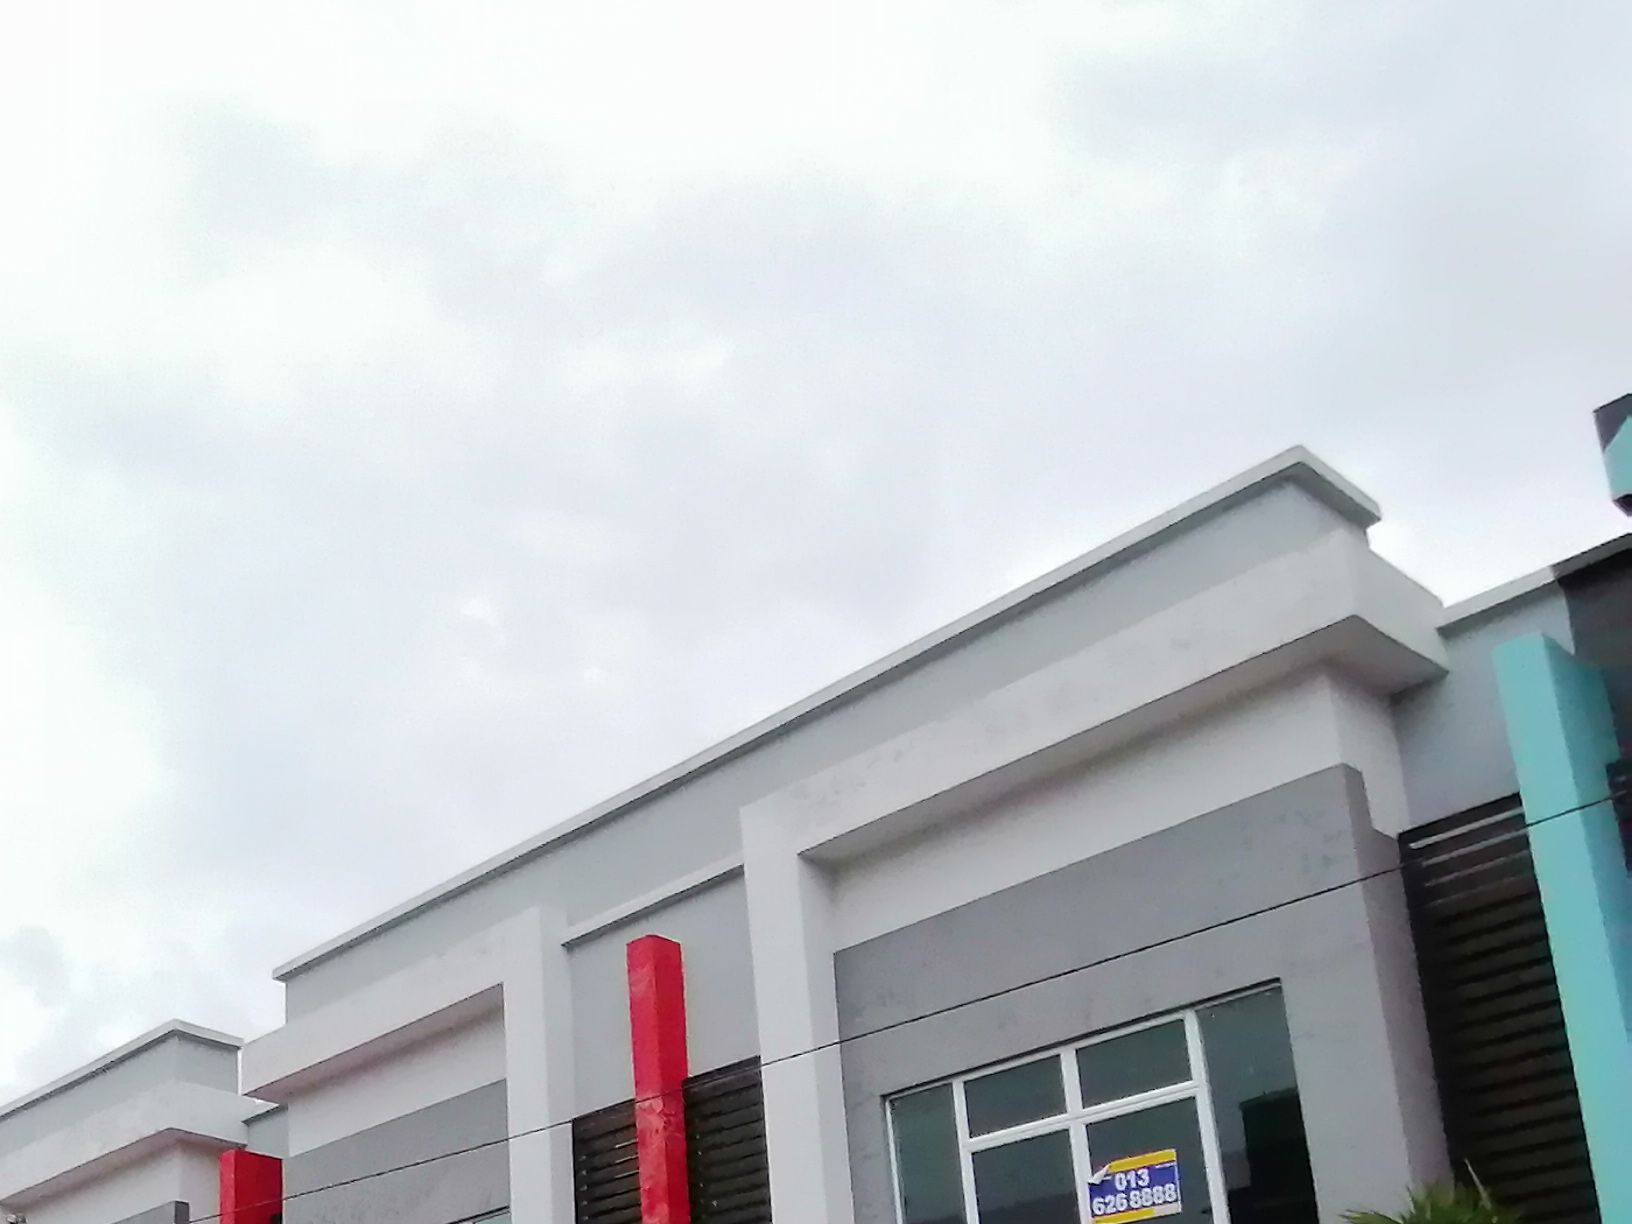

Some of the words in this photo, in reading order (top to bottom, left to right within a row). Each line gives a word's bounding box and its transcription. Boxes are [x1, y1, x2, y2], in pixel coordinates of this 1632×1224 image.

[1114, 1168, 1150, 1191] 013
[1092, 1193, 1128, 1215] 626
[1129, 1183, 1177, 1208] 8888
